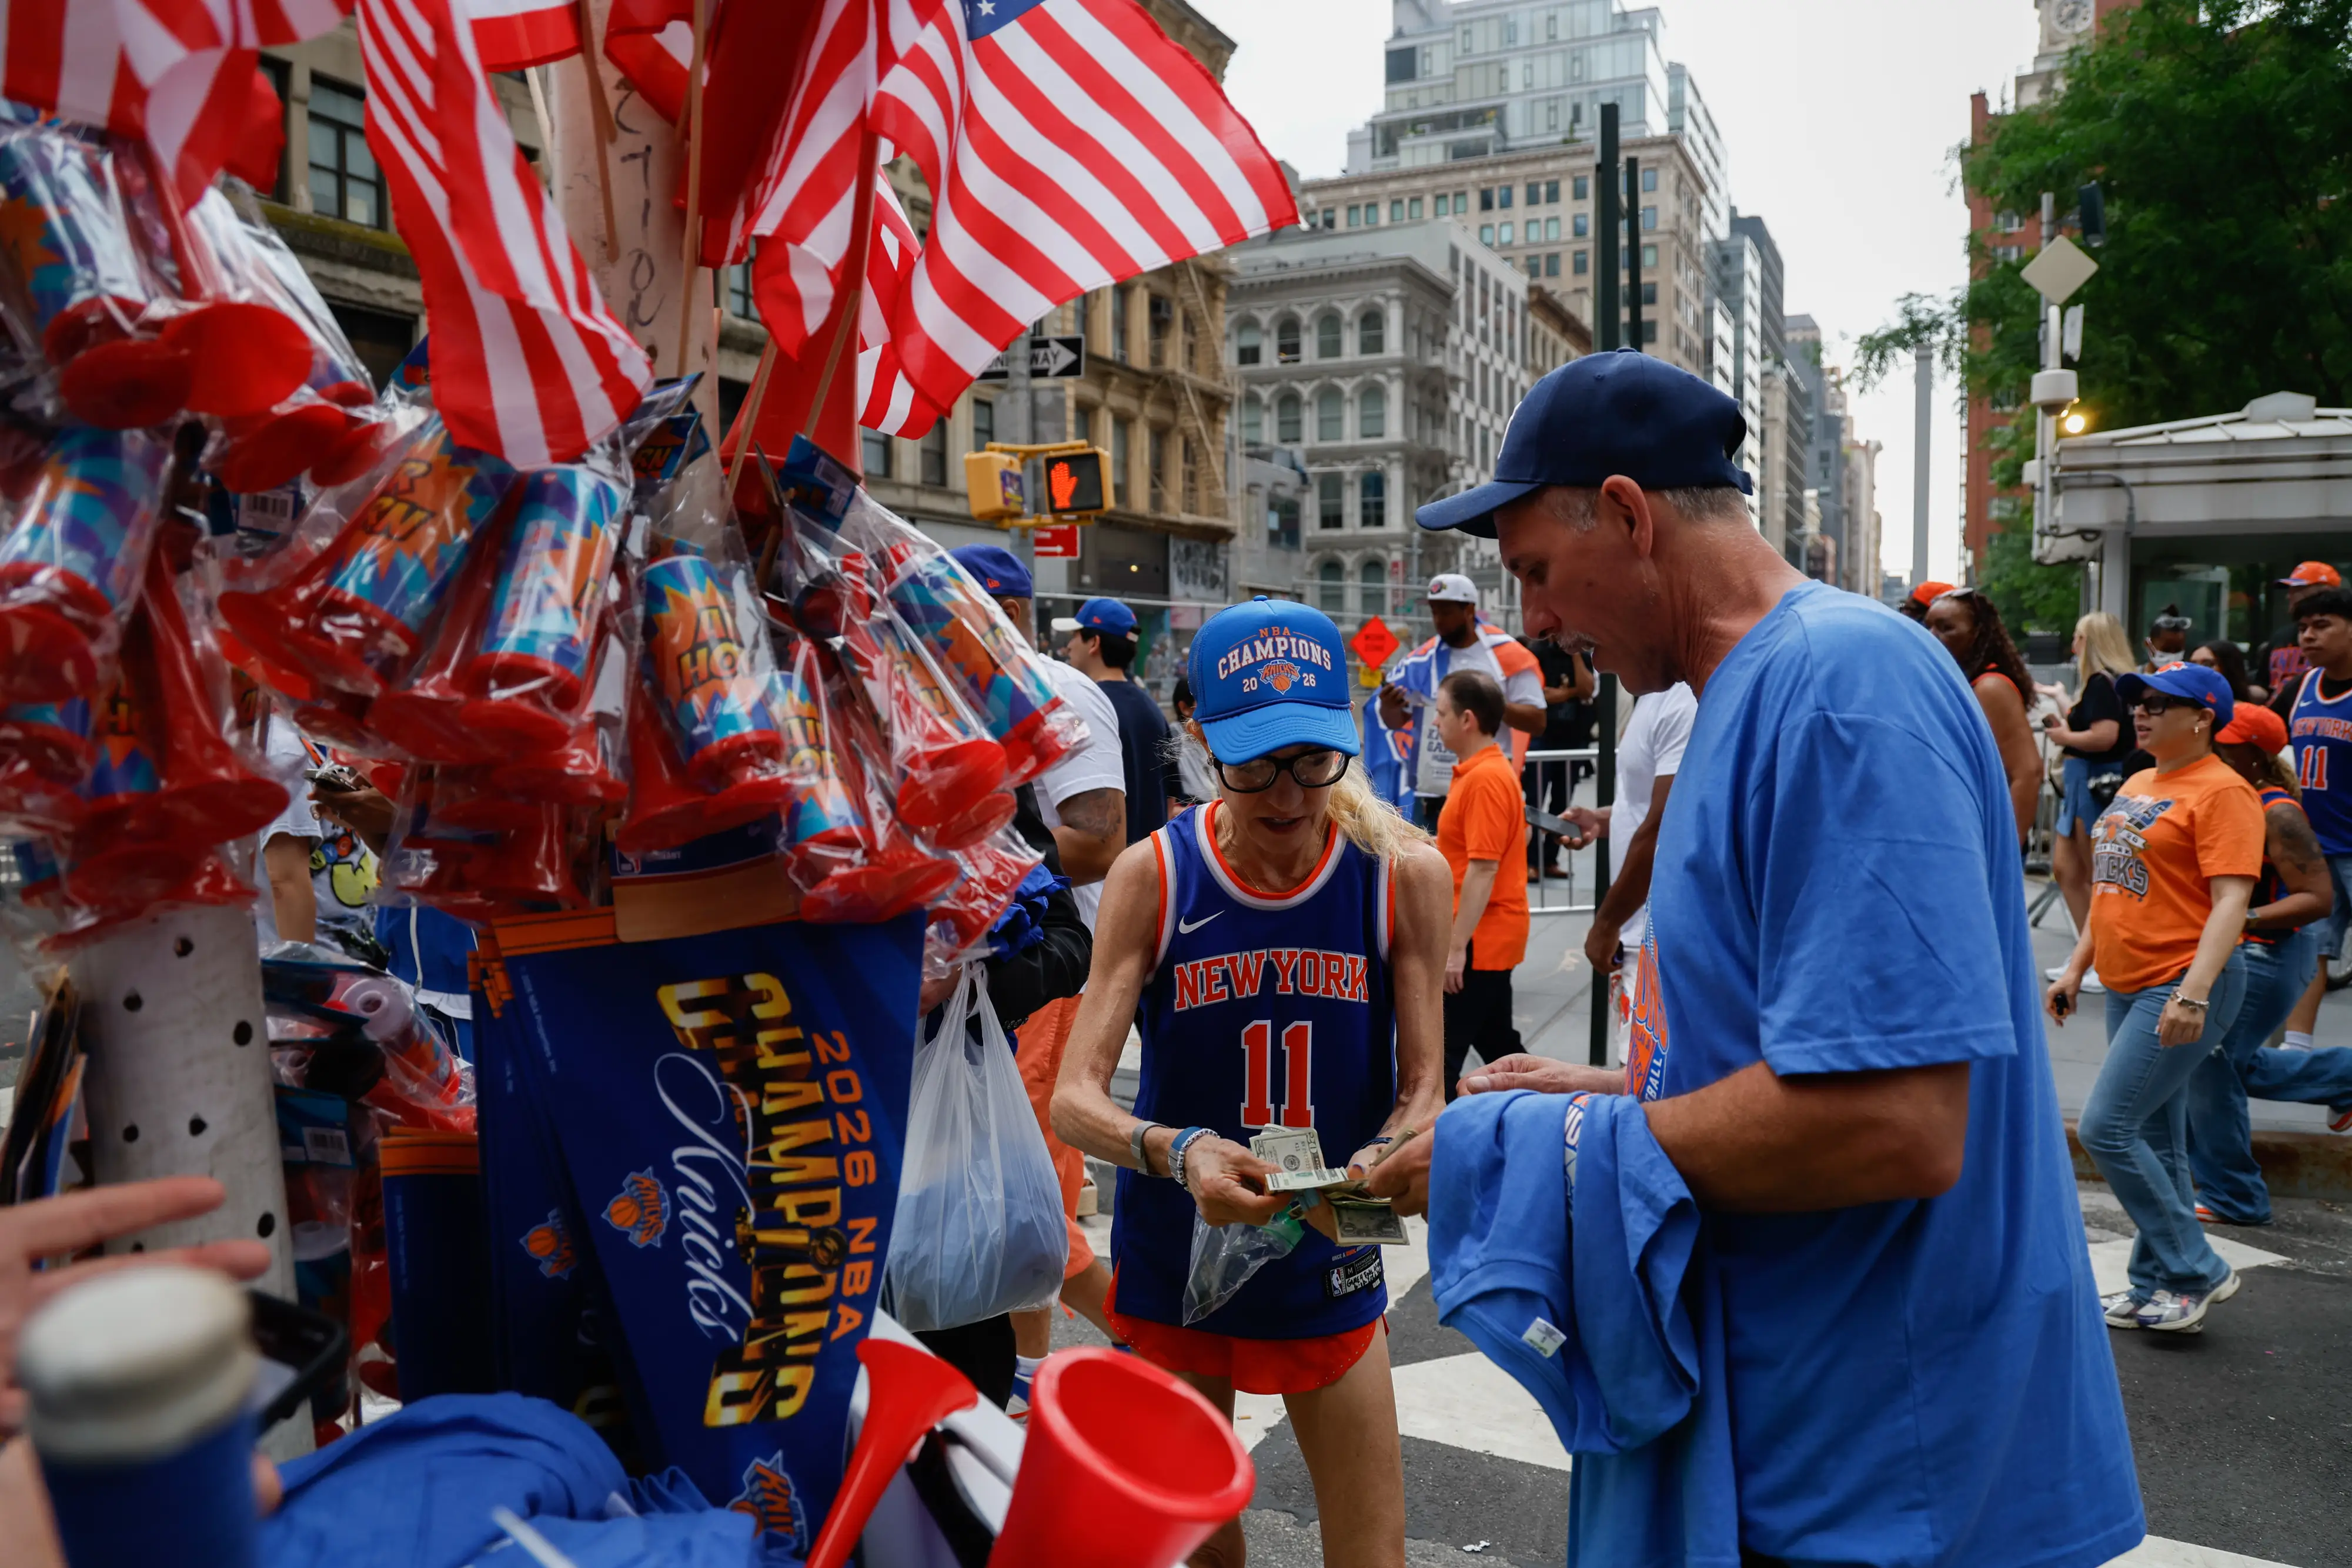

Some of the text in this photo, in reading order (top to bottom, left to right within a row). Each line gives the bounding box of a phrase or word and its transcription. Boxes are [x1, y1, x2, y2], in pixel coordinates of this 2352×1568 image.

[1259, 627, 1291, 638] NBA
[1218, 636, 1332, 680] CHAMPIONS
[1261, 663, 1298, 680] KNICKS
[1302, 673, 1316, 687] 26
[1242, 677, 1258, 693] 20
[2300, 744, 2328, 790] 11
[1174, 948, 1369, 1012] NEW YORK
[1240, 1019, 1315, 1129] 11
[654, 1052, 757, 1343] Knicks
[813, 1029, 878, 1342] 2026 NBA
[632, 1175, 666, 1245] KNICKS
